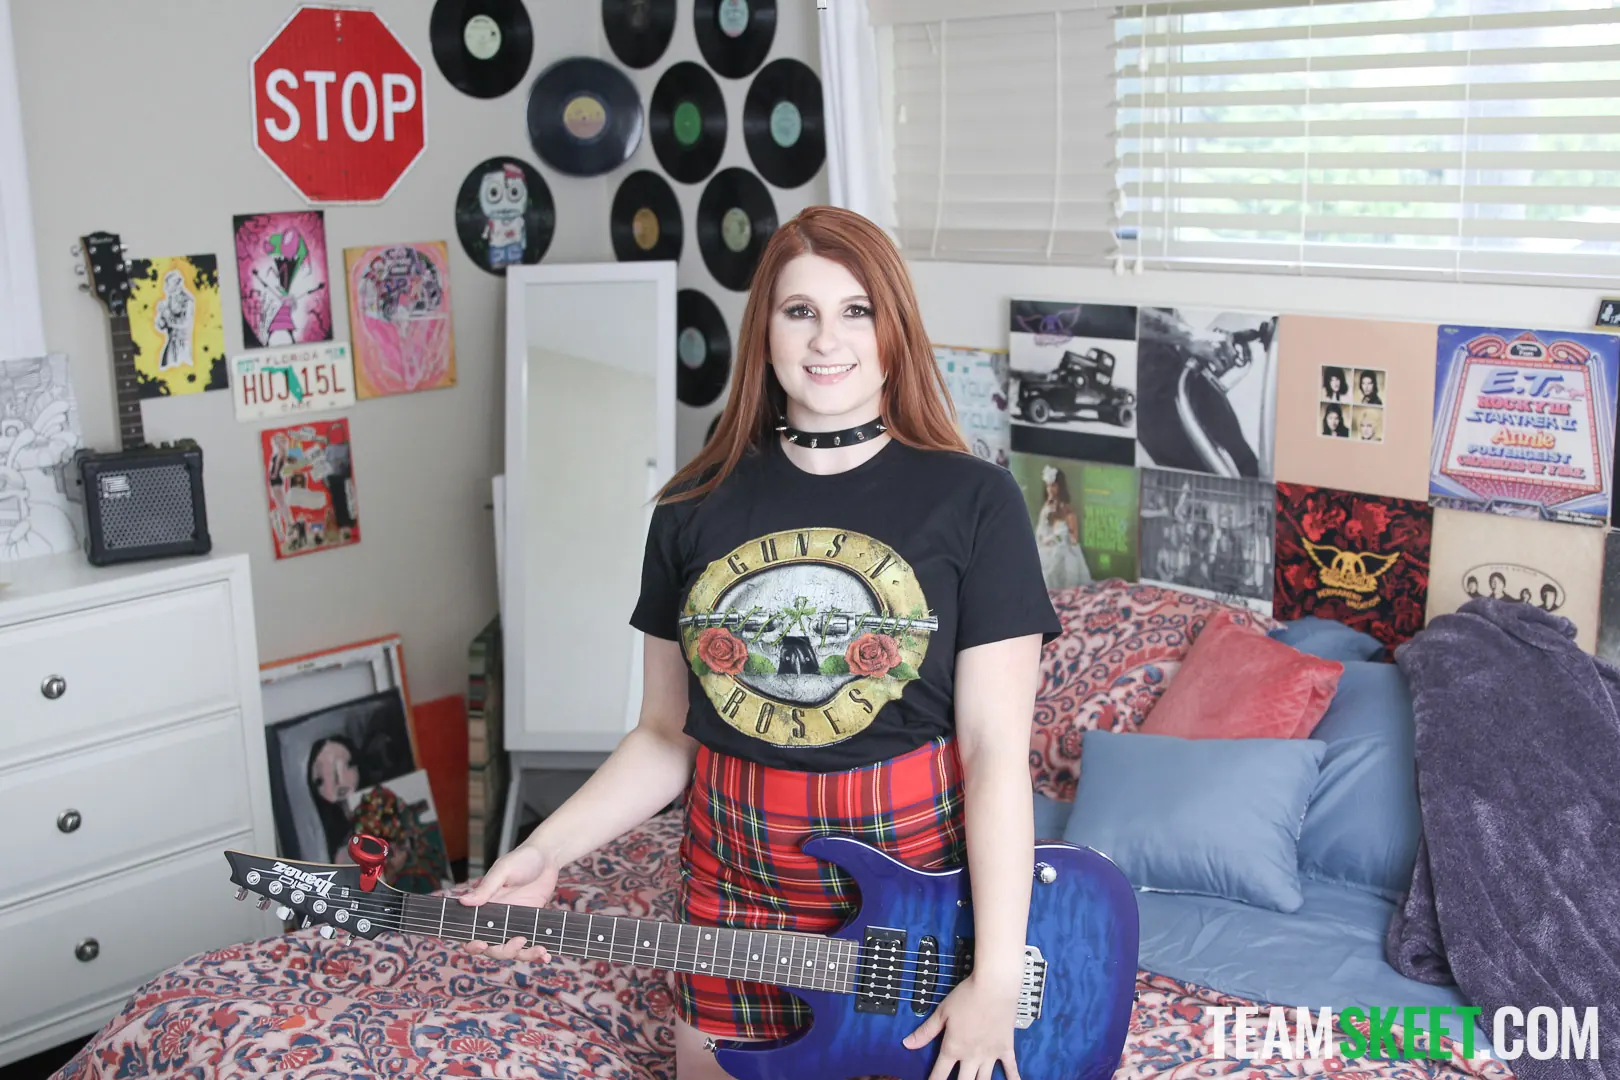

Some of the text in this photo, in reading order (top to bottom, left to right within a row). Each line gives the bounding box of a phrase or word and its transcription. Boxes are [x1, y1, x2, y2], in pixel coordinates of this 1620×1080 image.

[264, 68, 416, 142] STOP
[301, 363, 346, 397] 15L
[1481, 367, 1565, 398] E.T.
[1477, 396, 1572, 417] ROCKY III
[1492, 427, 1556, 449] Annie
[727, 531, 848, 575] GUNS
[722, 687, 874, 739] ROSES
[272, 861, 337, 899] Ibanez
